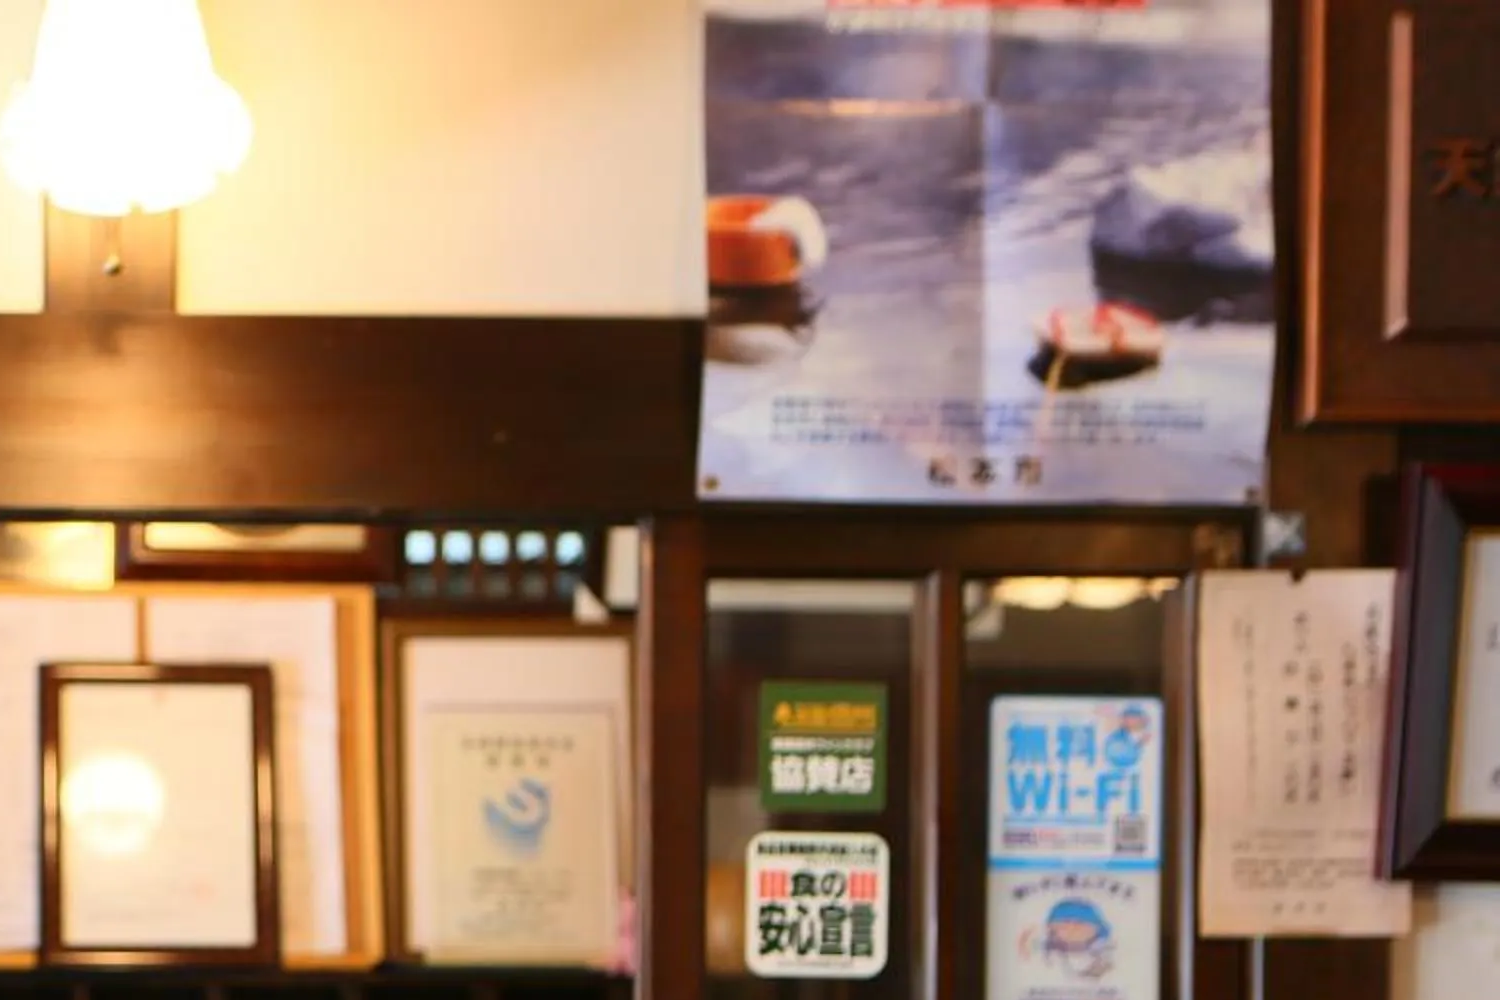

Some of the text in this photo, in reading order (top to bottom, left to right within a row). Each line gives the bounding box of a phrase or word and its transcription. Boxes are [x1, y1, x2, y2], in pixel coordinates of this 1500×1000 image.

[1007, 770, 1140, 815] Wi-Fi
[789, 870, 846, 898] 食の
[757, 903, 876, 957] 安心宣言
